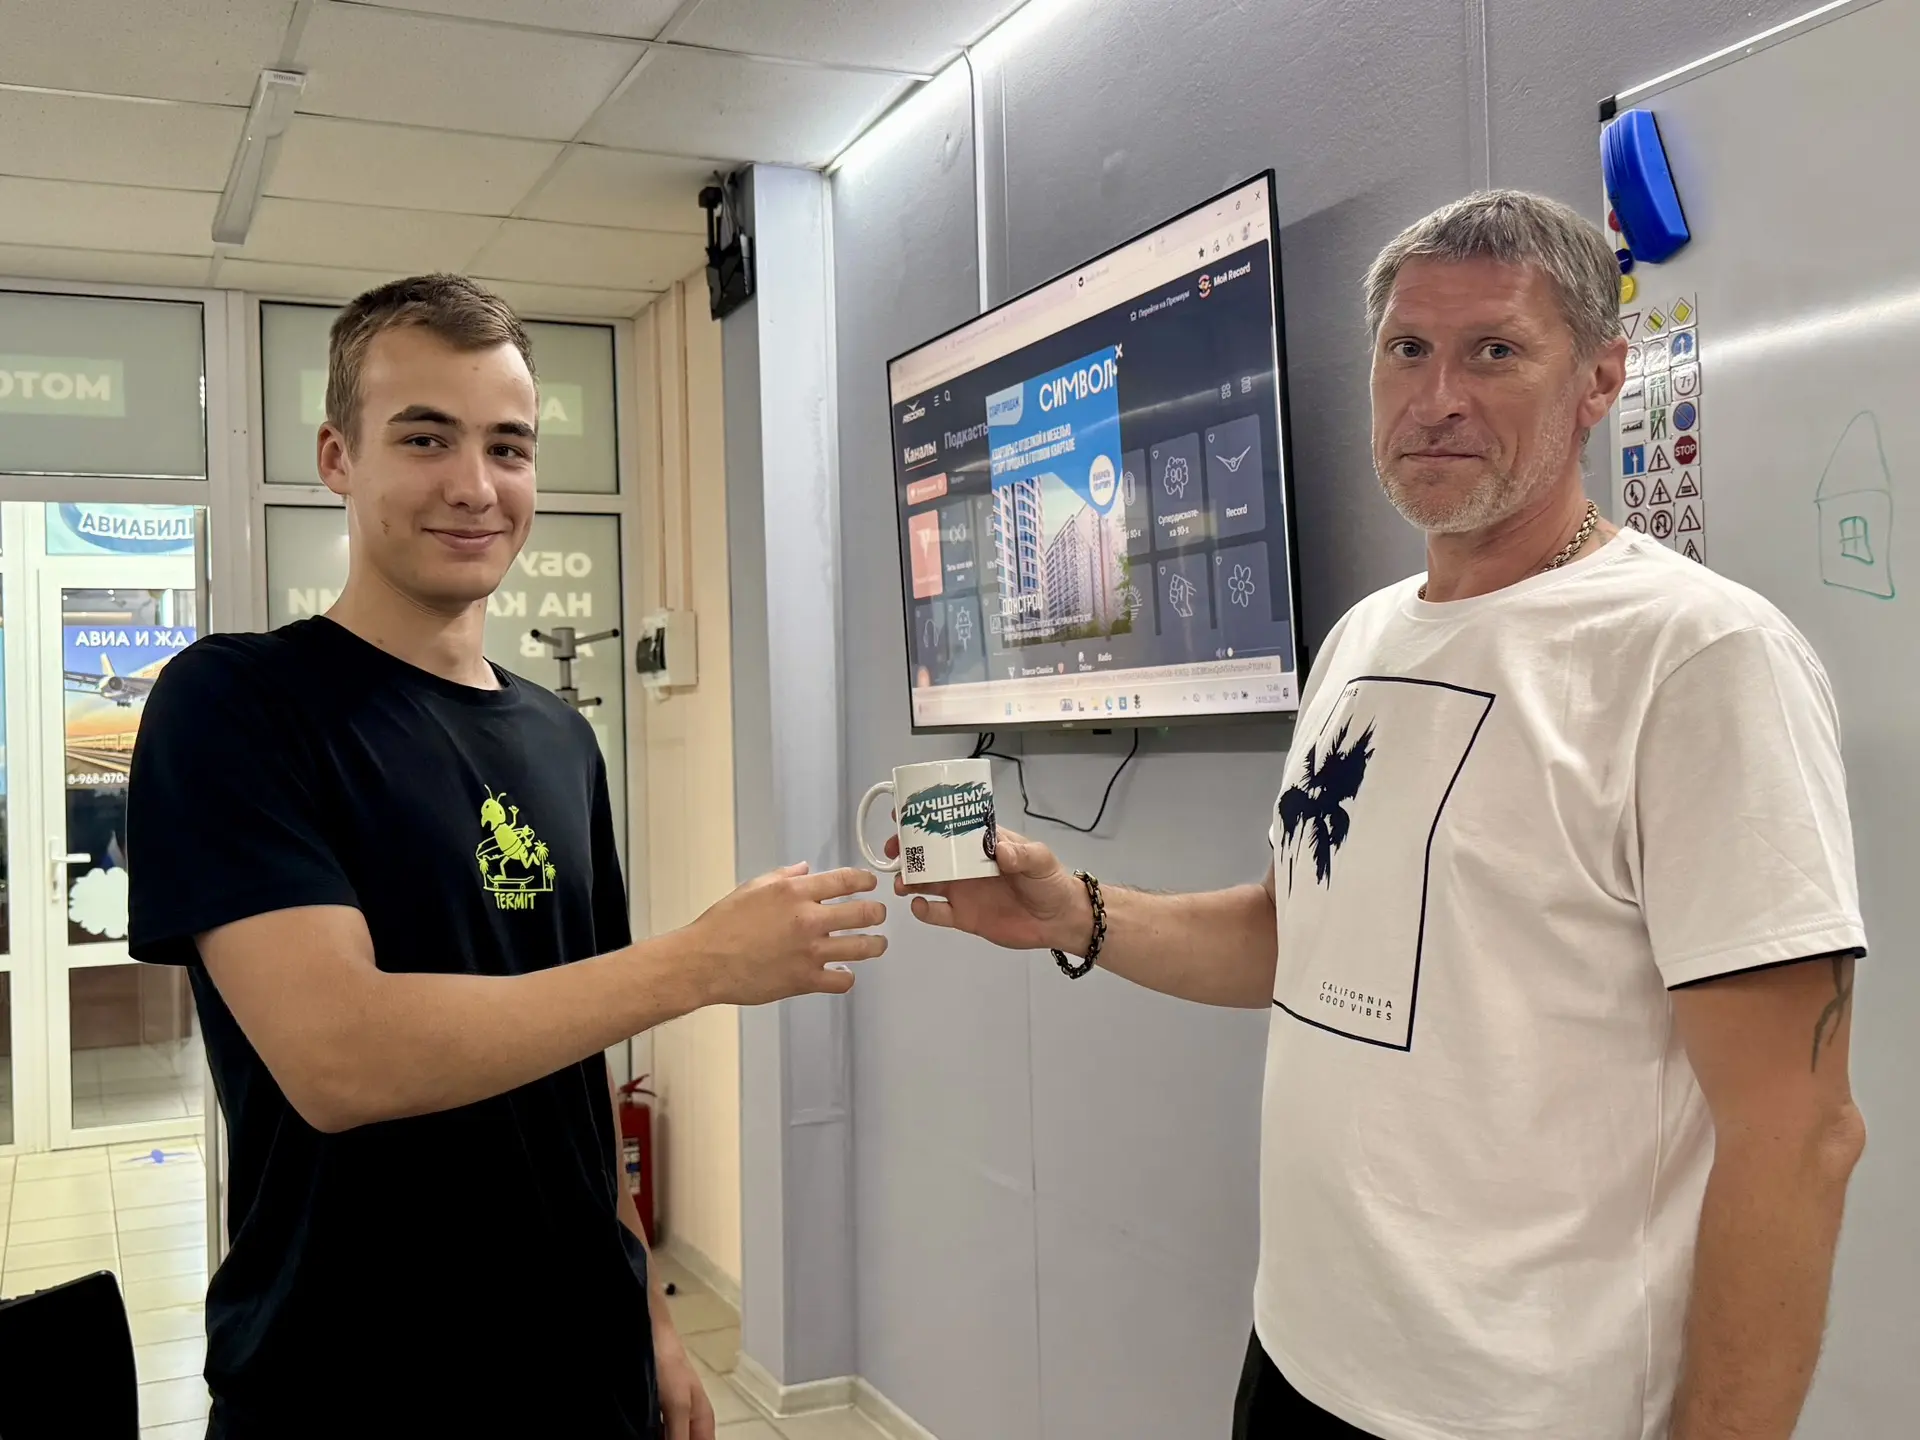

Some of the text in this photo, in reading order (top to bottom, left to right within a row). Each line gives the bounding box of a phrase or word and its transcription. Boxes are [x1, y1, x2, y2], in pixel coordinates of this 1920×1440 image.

[1213, 262, 1251, 287] Мой Record
[1039, 358, 1114, 412] СИМВОЛ
[903, 440, 937, 464] Каналы
[1674, 444, 1697, 458] STOP
[1226, 504, 1248, 518] Record
[82, 512, 194, 537] АВИАБИЛ
[75, 630, 189, 649] АВИА И ЖД
[1097, 652, 1113, 662] Radio
[906, 787, 984, 818] ЛУЧШЕМУ
[943, 816, 984, 831] АВТОШКОЛЫ
[494, 892, 537, 910] TERMIT
[1319, 993, 1392, 1021] GOOD VIBES
[1322, 981, 1393, 1009] CALIFORNIA
